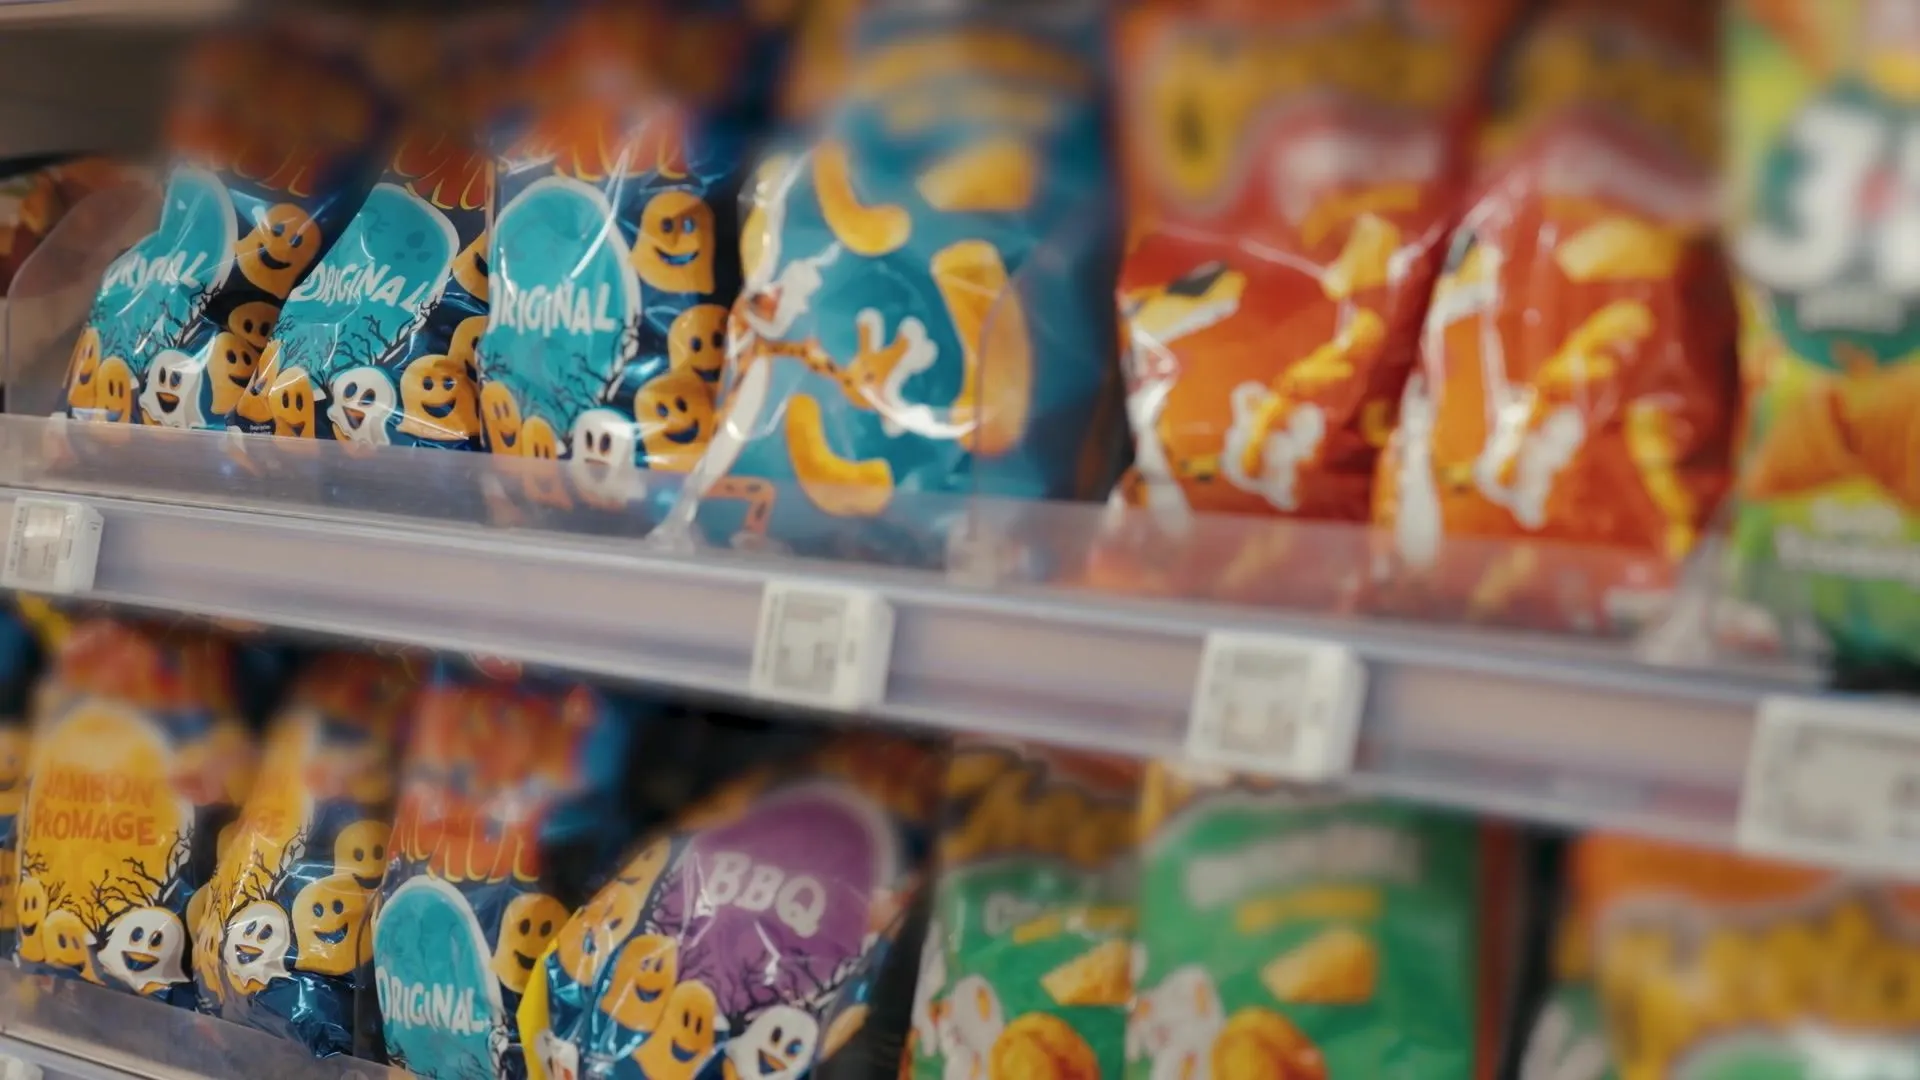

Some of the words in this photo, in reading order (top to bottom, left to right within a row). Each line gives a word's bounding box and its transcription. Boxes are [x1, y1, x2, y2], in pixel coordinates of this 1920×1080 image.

[33, 797, 157, 846] FROMAGE
[707, 850, 827, 939] BBQ
[374, 965, 486, 1036] ORIGINAL
